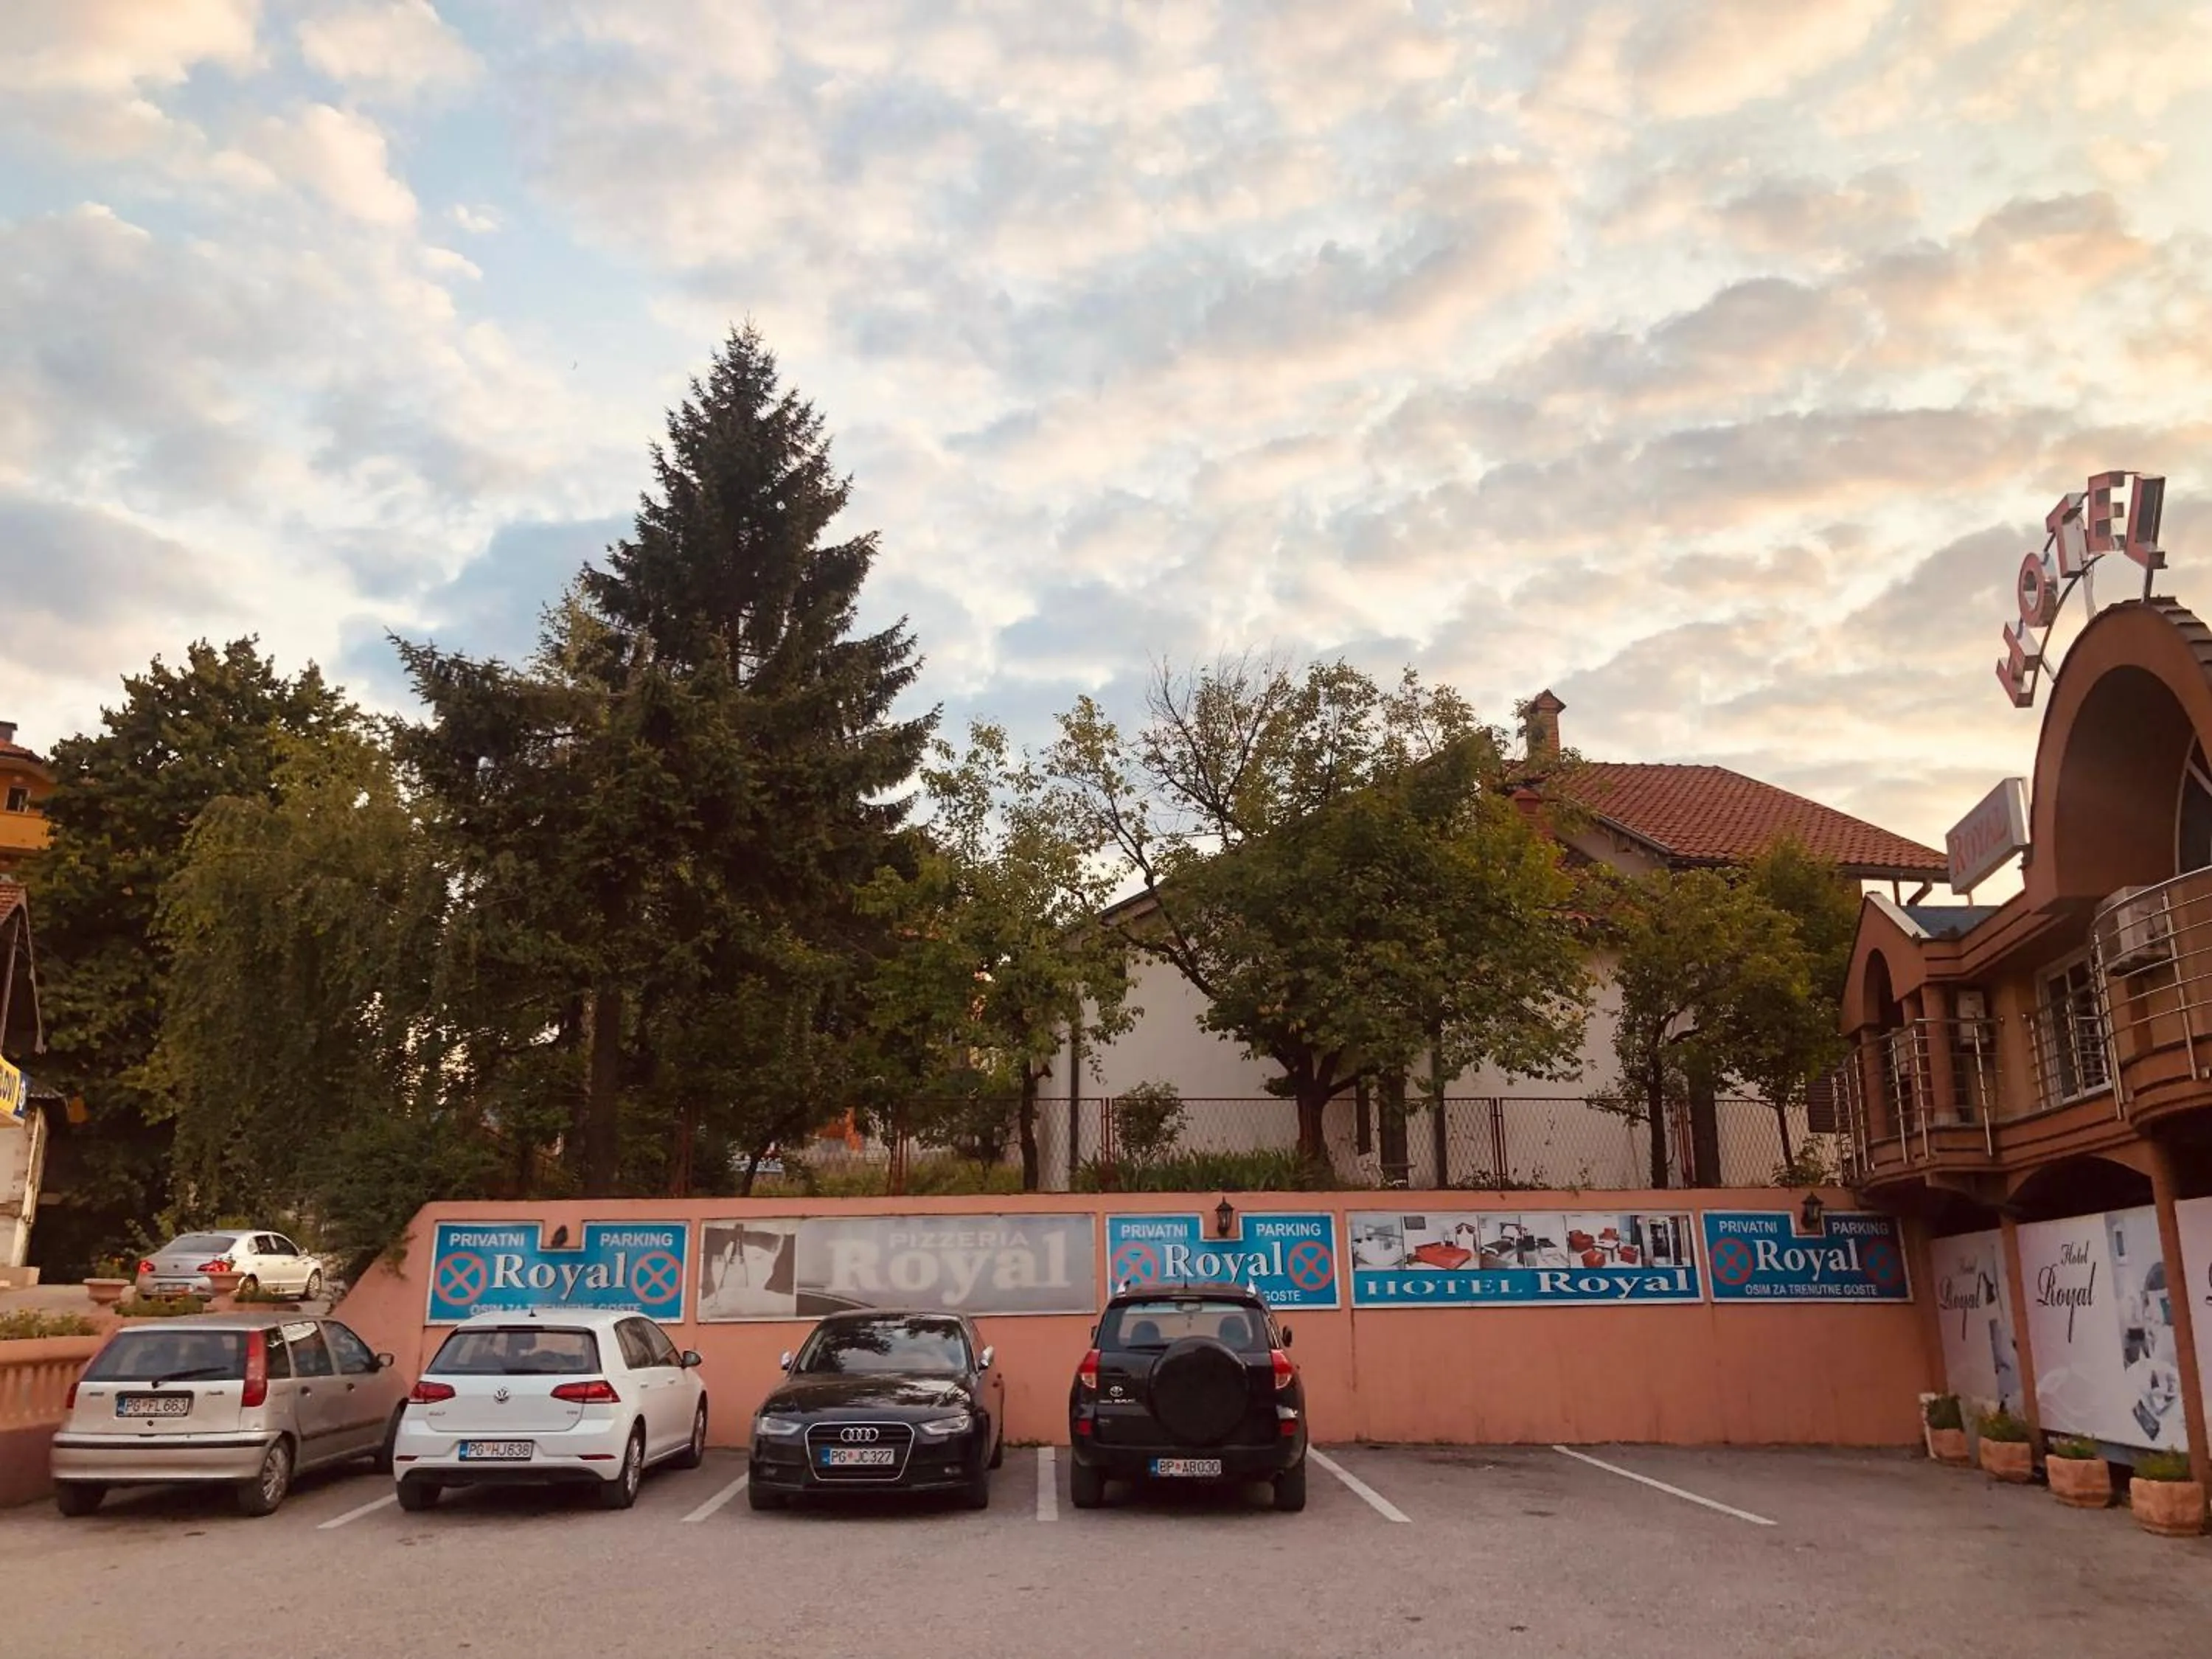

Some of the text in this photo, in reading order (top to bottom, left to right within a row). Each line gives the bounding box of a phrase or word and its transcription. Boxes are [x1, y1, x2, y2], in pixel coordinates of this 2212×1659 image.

[1996, 470, 2168, 708] HOTEL
[449, 1232, 673, 1246] PRIVATNI PARKING
[1121, 1223, 1321, 1238] PRIVATNI PARKING
[1719, 1220, 1889, 1235] PRIVATNI PARKING
[888, 1231, 1030, 1249] PIZZERIA
[826, 1231, 1071, 1305] Royal
[1162, 1241, 1284, 1282] Royal
[1753, 1239, 1863, 1281] Royal
[490, 1252, 626, 1300] Royal
[1366, 1269, 1691, 1298] HOTEL Royal
[1745, 1284, 1877, 1295] OSIM ZA TRENUTNE GOSTE
[2036, 1262, 2096, 1343] Royal
[468, 1444, 484, 1455] PG
[831, 1450, 846, 1464] PG
